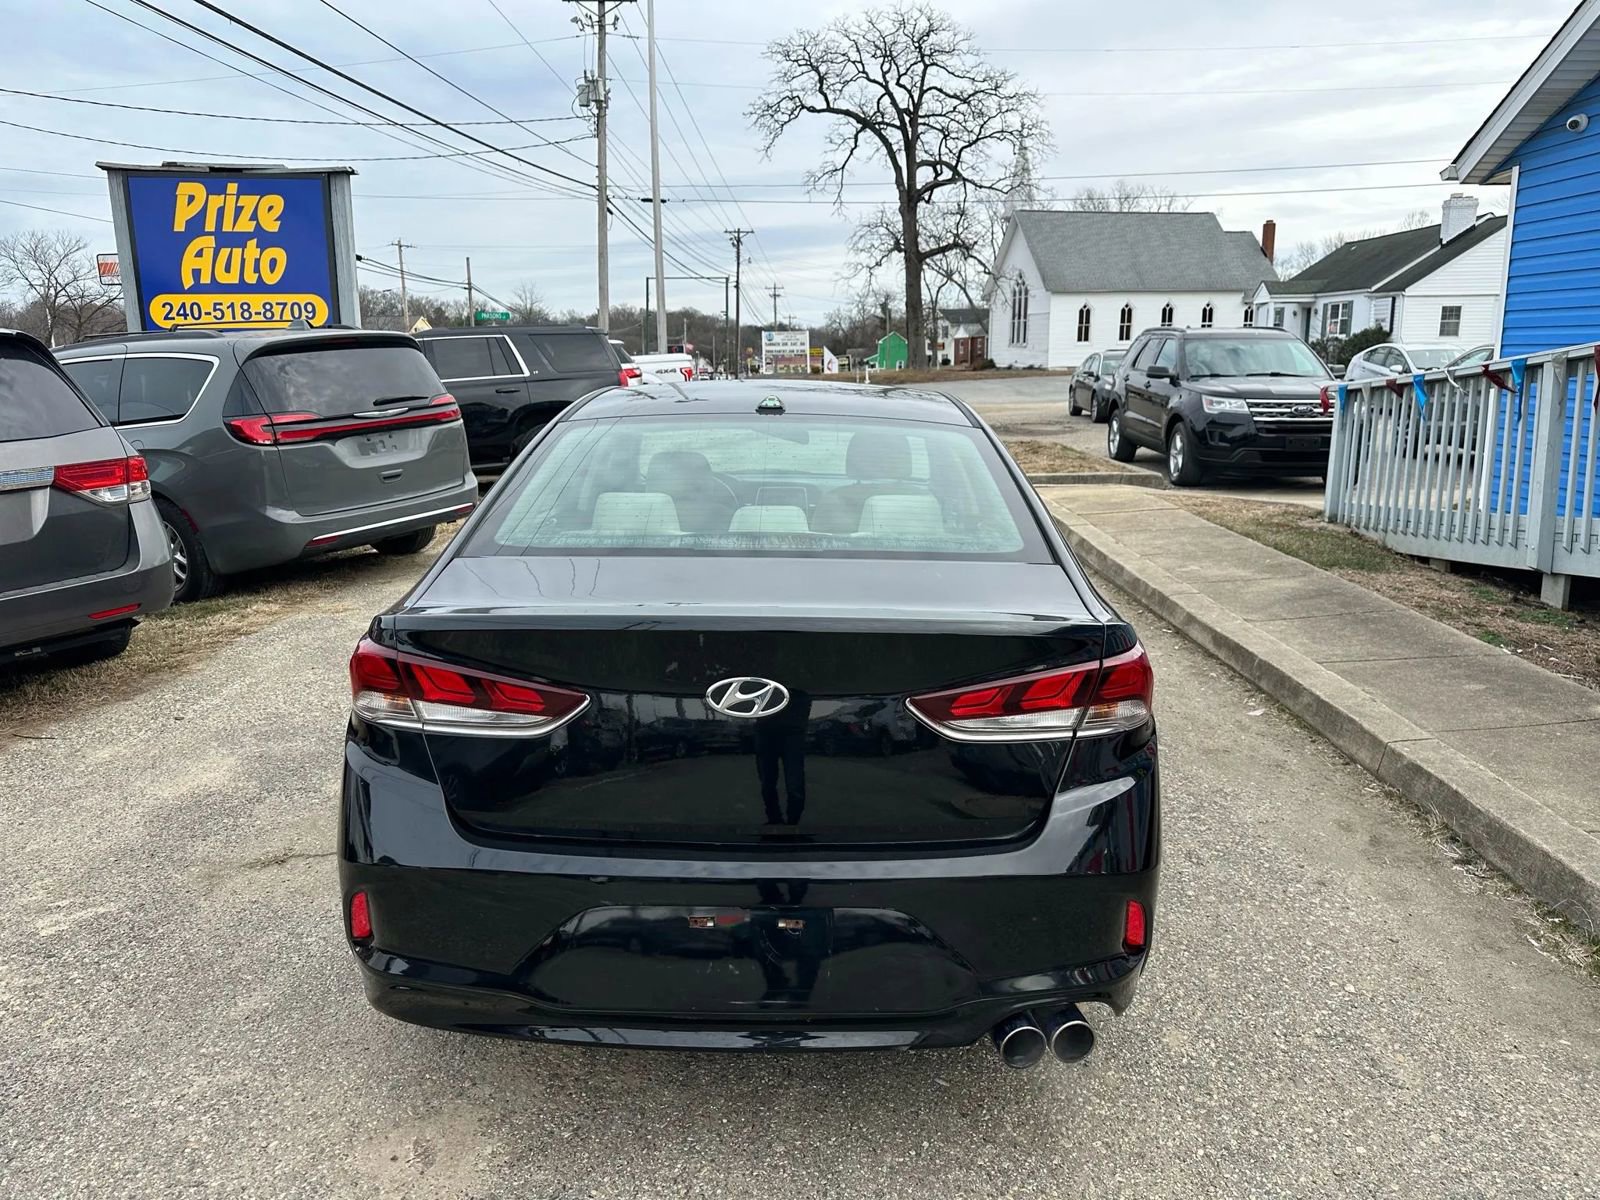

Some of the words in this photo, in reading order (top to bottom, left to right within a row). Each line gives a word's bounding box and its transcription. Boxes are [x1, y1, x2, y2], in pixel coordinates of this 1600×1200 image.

[173, 181, 285, 233] Prize
[181, 235, 287, 290] Auto
[161, 301, 317, 321] 240-518-8709
